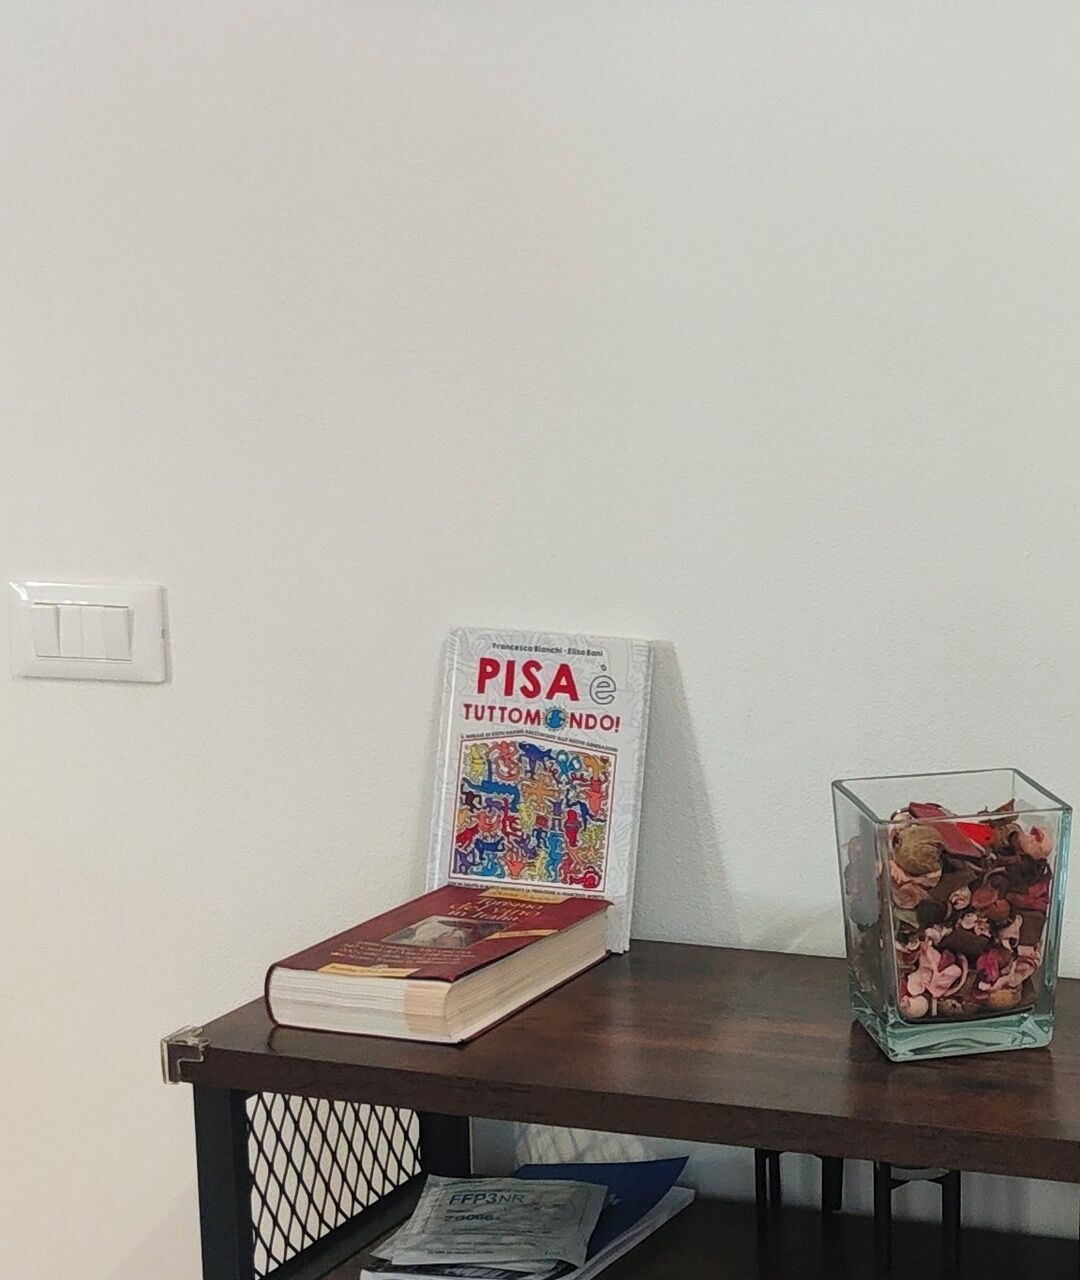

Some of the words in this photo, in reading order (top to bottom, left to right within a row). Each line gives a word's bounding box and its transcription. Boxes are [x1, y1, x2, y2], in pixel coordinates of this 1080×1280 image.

[534, 645, 563, 654] Bianchi
[567, 647, 586, 656] Elisa
[477, 657, 580, 701] PISA
[589, 664, 617, 705] è
